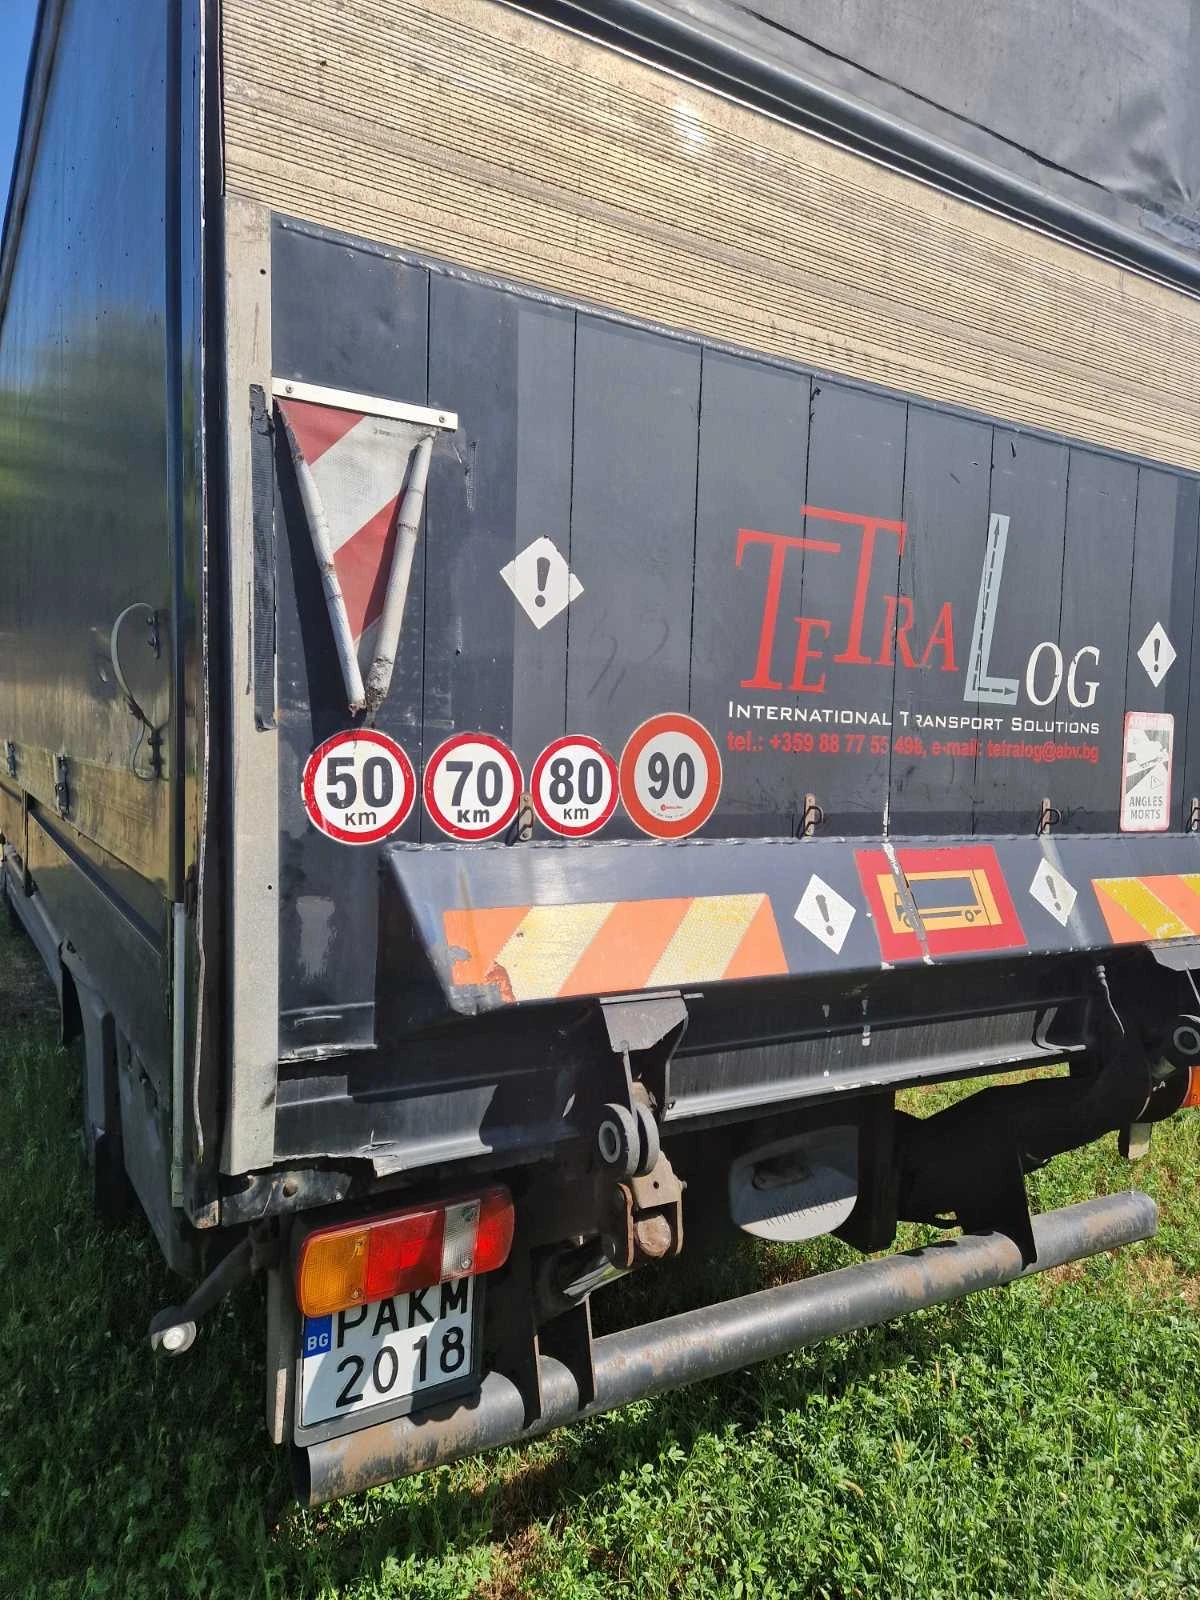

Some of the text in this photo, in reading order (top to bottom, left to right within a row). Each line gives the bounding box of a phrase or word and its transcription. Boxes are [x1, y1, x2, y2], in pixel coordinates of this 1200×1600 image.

[769, 731, 814, 753] +359
[819, 732, 841, 754] 88
[845, 734, 867, 755] 77
[326, 756, 394, 809] 50
[445, 760, 504, 807] 70
[549, 757, 603, 805] 80
[647, 751, 696, 800] 90
[1129, 795, 1163, 807] ANGLES
[1130, 809, 1161, 820] MORTS
[307, 1332, 329, 1352] BG
[335, 1326, 466, 1409] 2018
